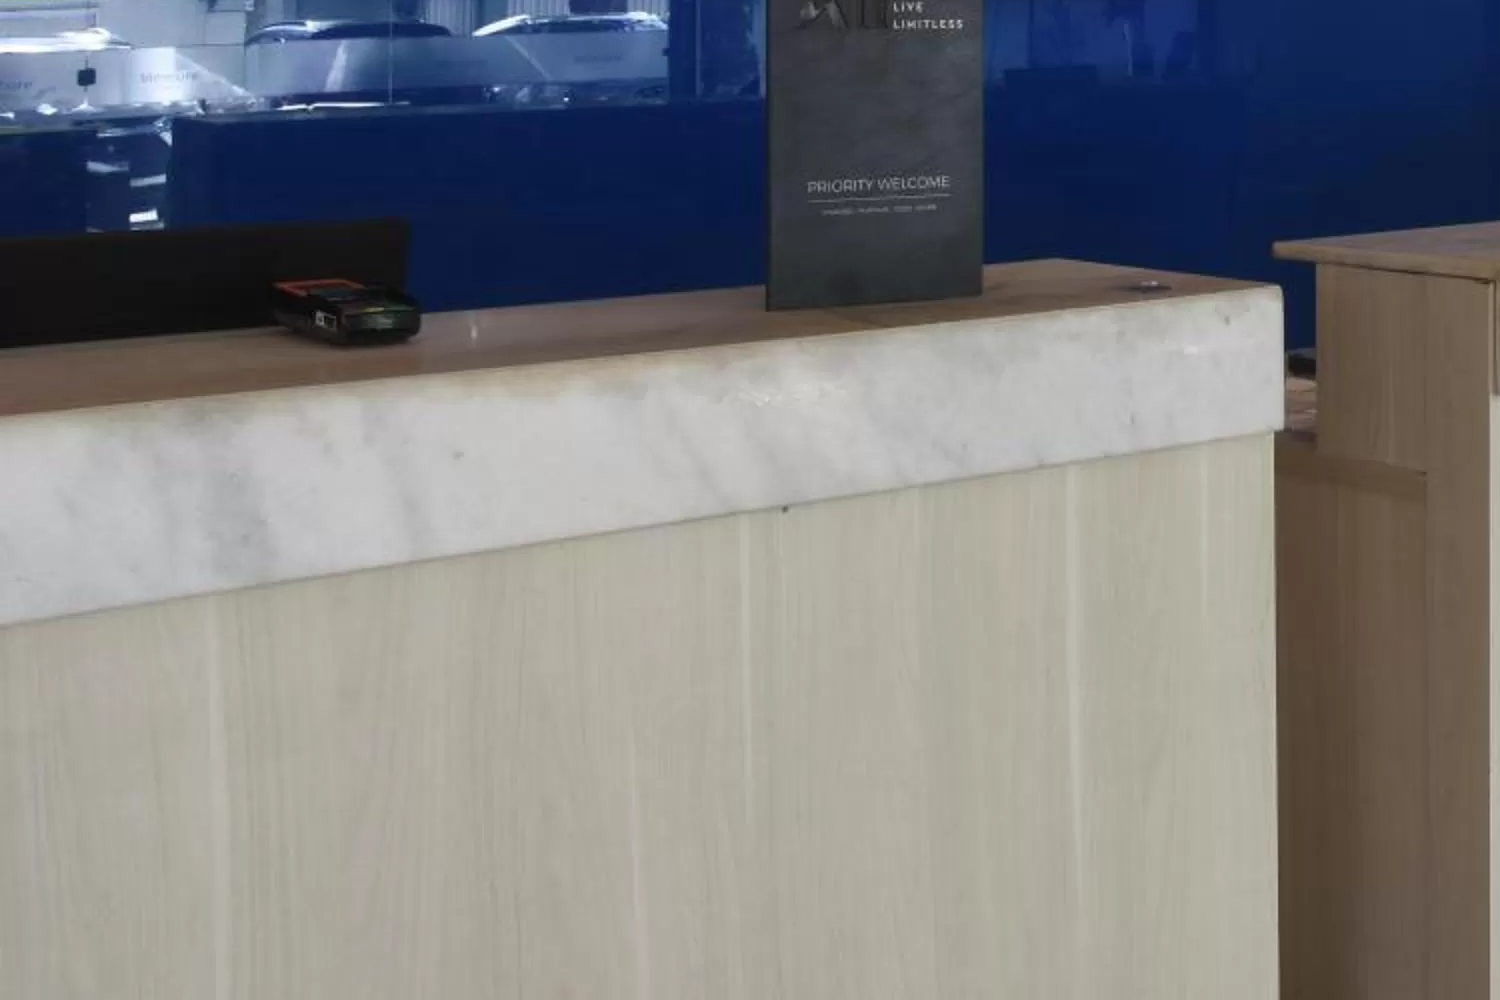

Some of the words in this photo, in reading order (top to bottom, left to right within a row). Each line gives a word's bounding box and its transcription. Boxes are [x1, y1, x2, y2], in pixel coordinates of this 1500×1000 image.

[893, 1, 925, 13] LIVE
[893, 19, 964, 29] LIMITLESS
[807, 179, 873, 193] PRIORITY
[877, 175, 950, 190] WELCOME
